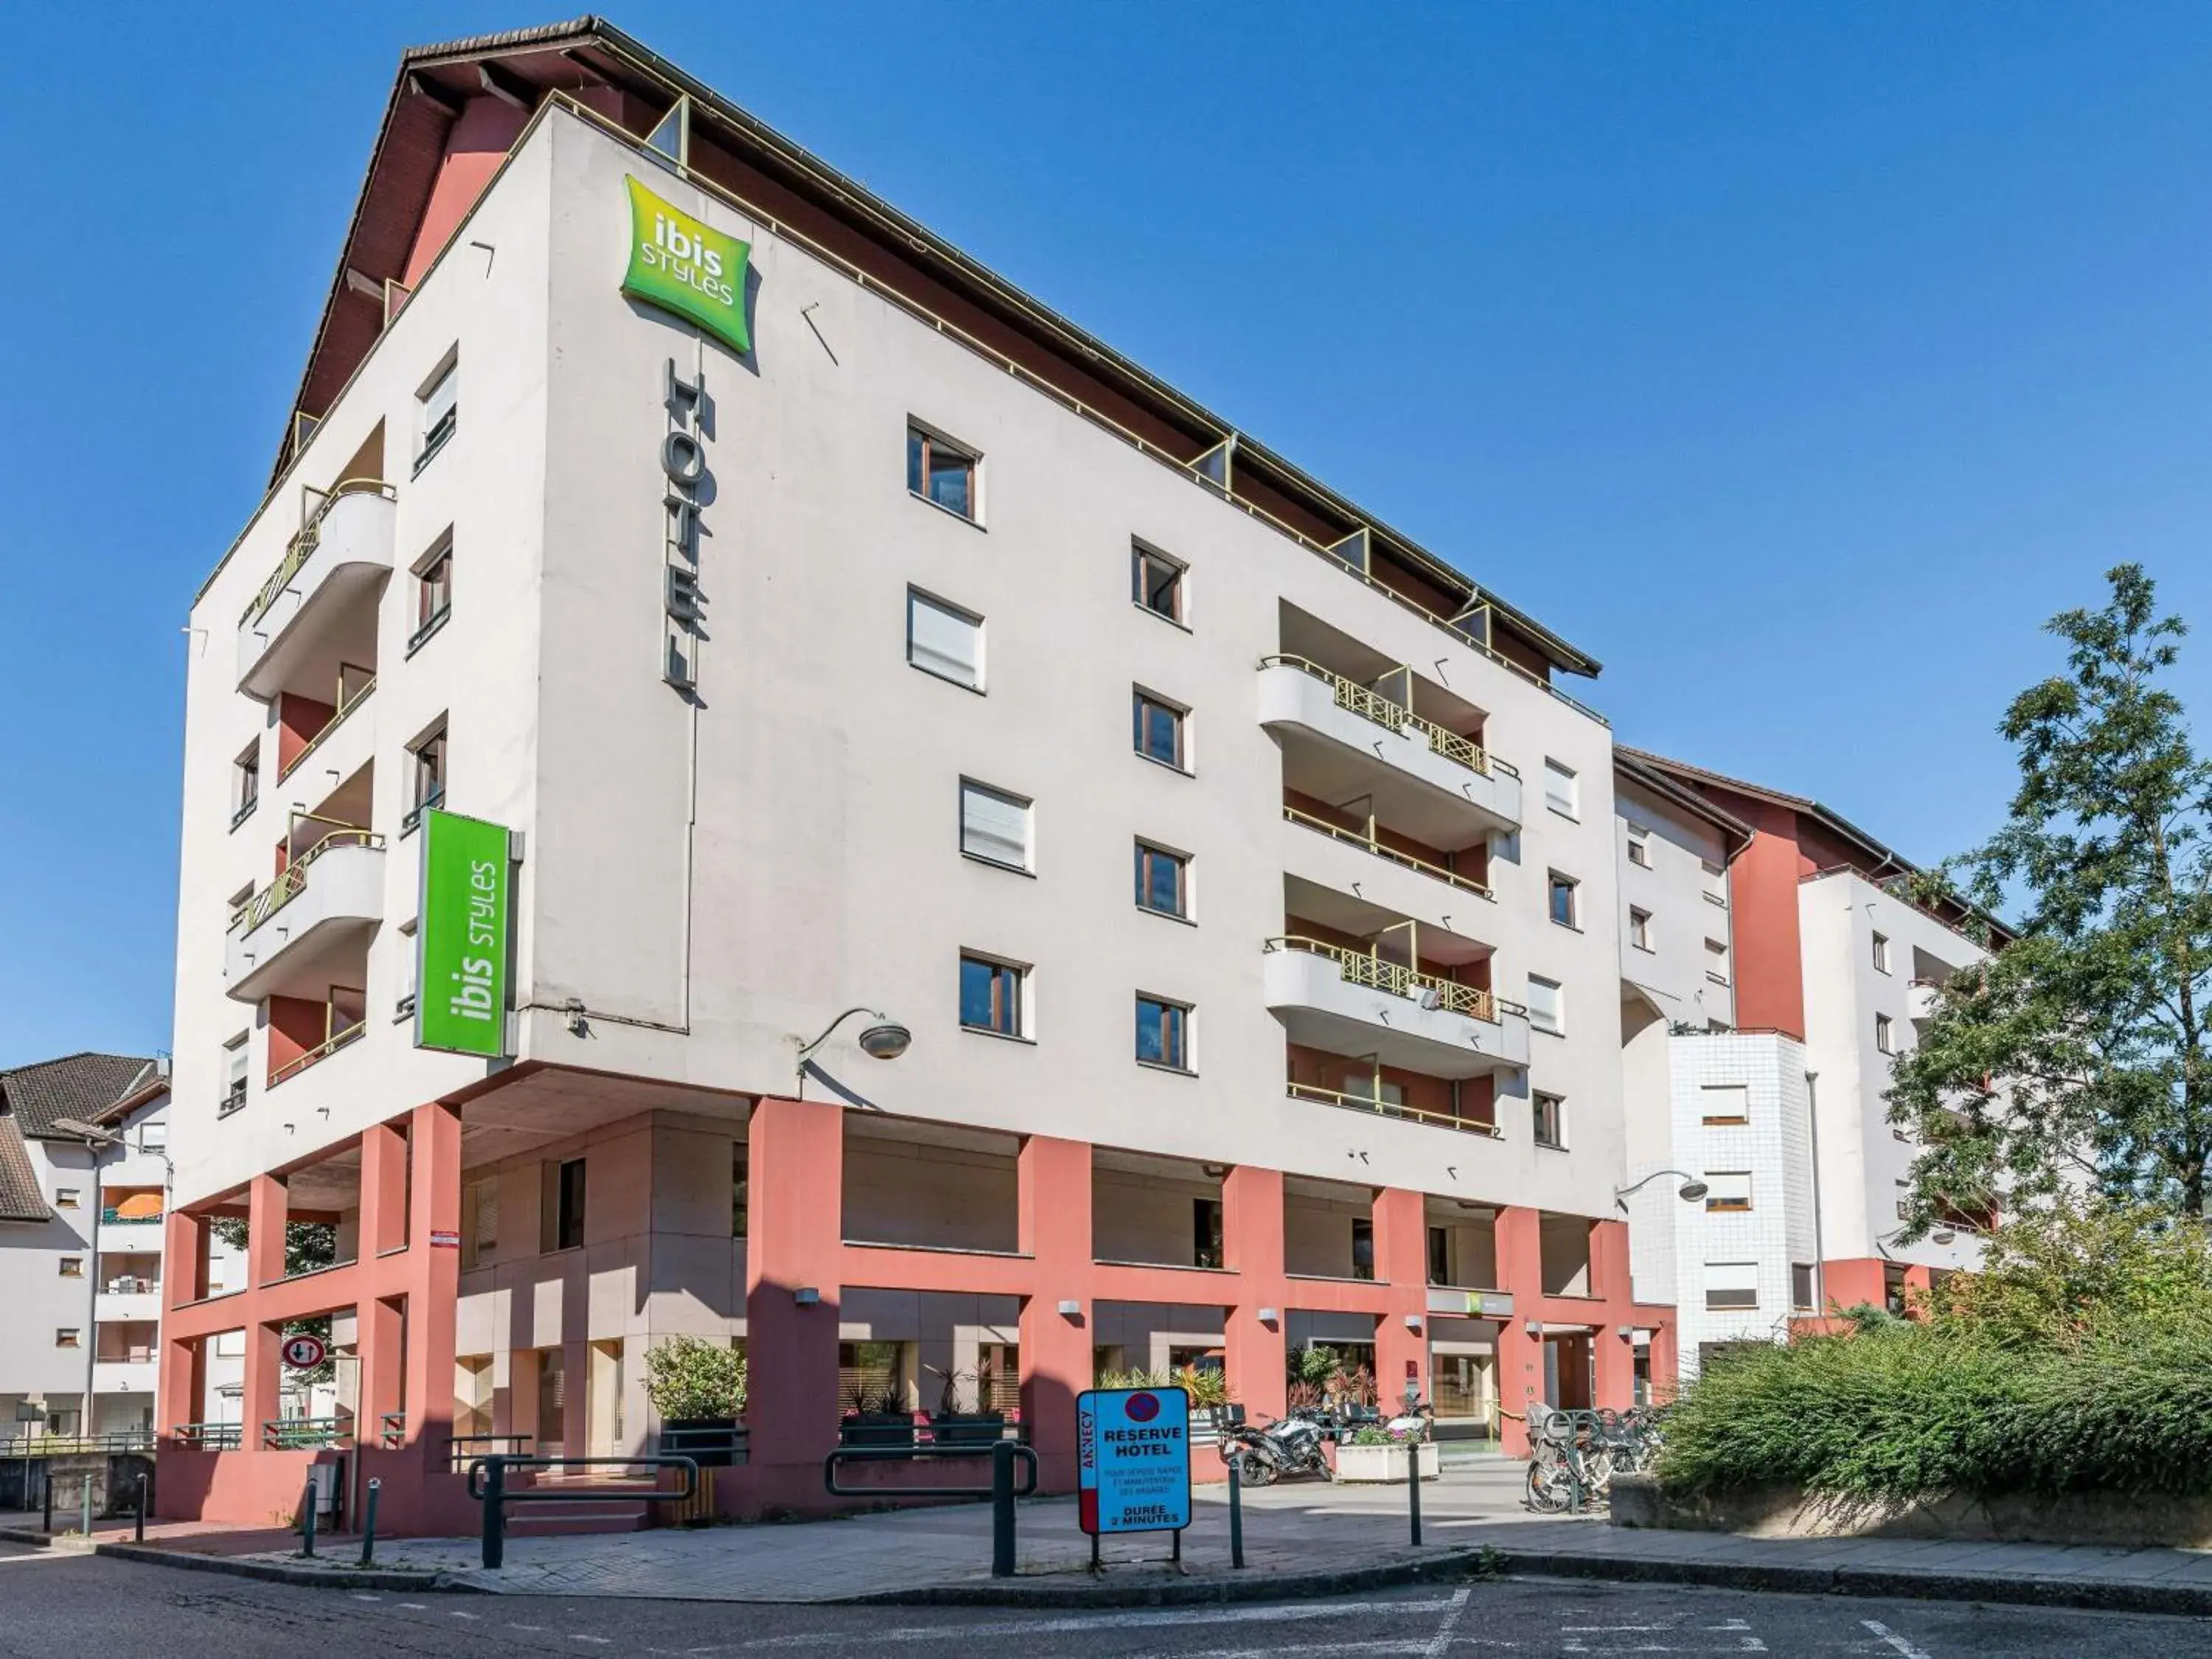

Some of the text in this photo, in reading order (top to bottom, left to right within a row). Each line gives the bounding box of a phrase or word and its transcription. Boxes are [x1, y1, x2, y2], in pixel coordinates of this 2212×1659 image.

[655, 212, 723, 278] ibis
[661, 357, 706, 689] HOTEL
[451, 956, 493, 1020] ibis
[1081, 1410, 1094, 1469] ANNECY
[1111, 1514, 1179, 1526] 2 MINUTES
